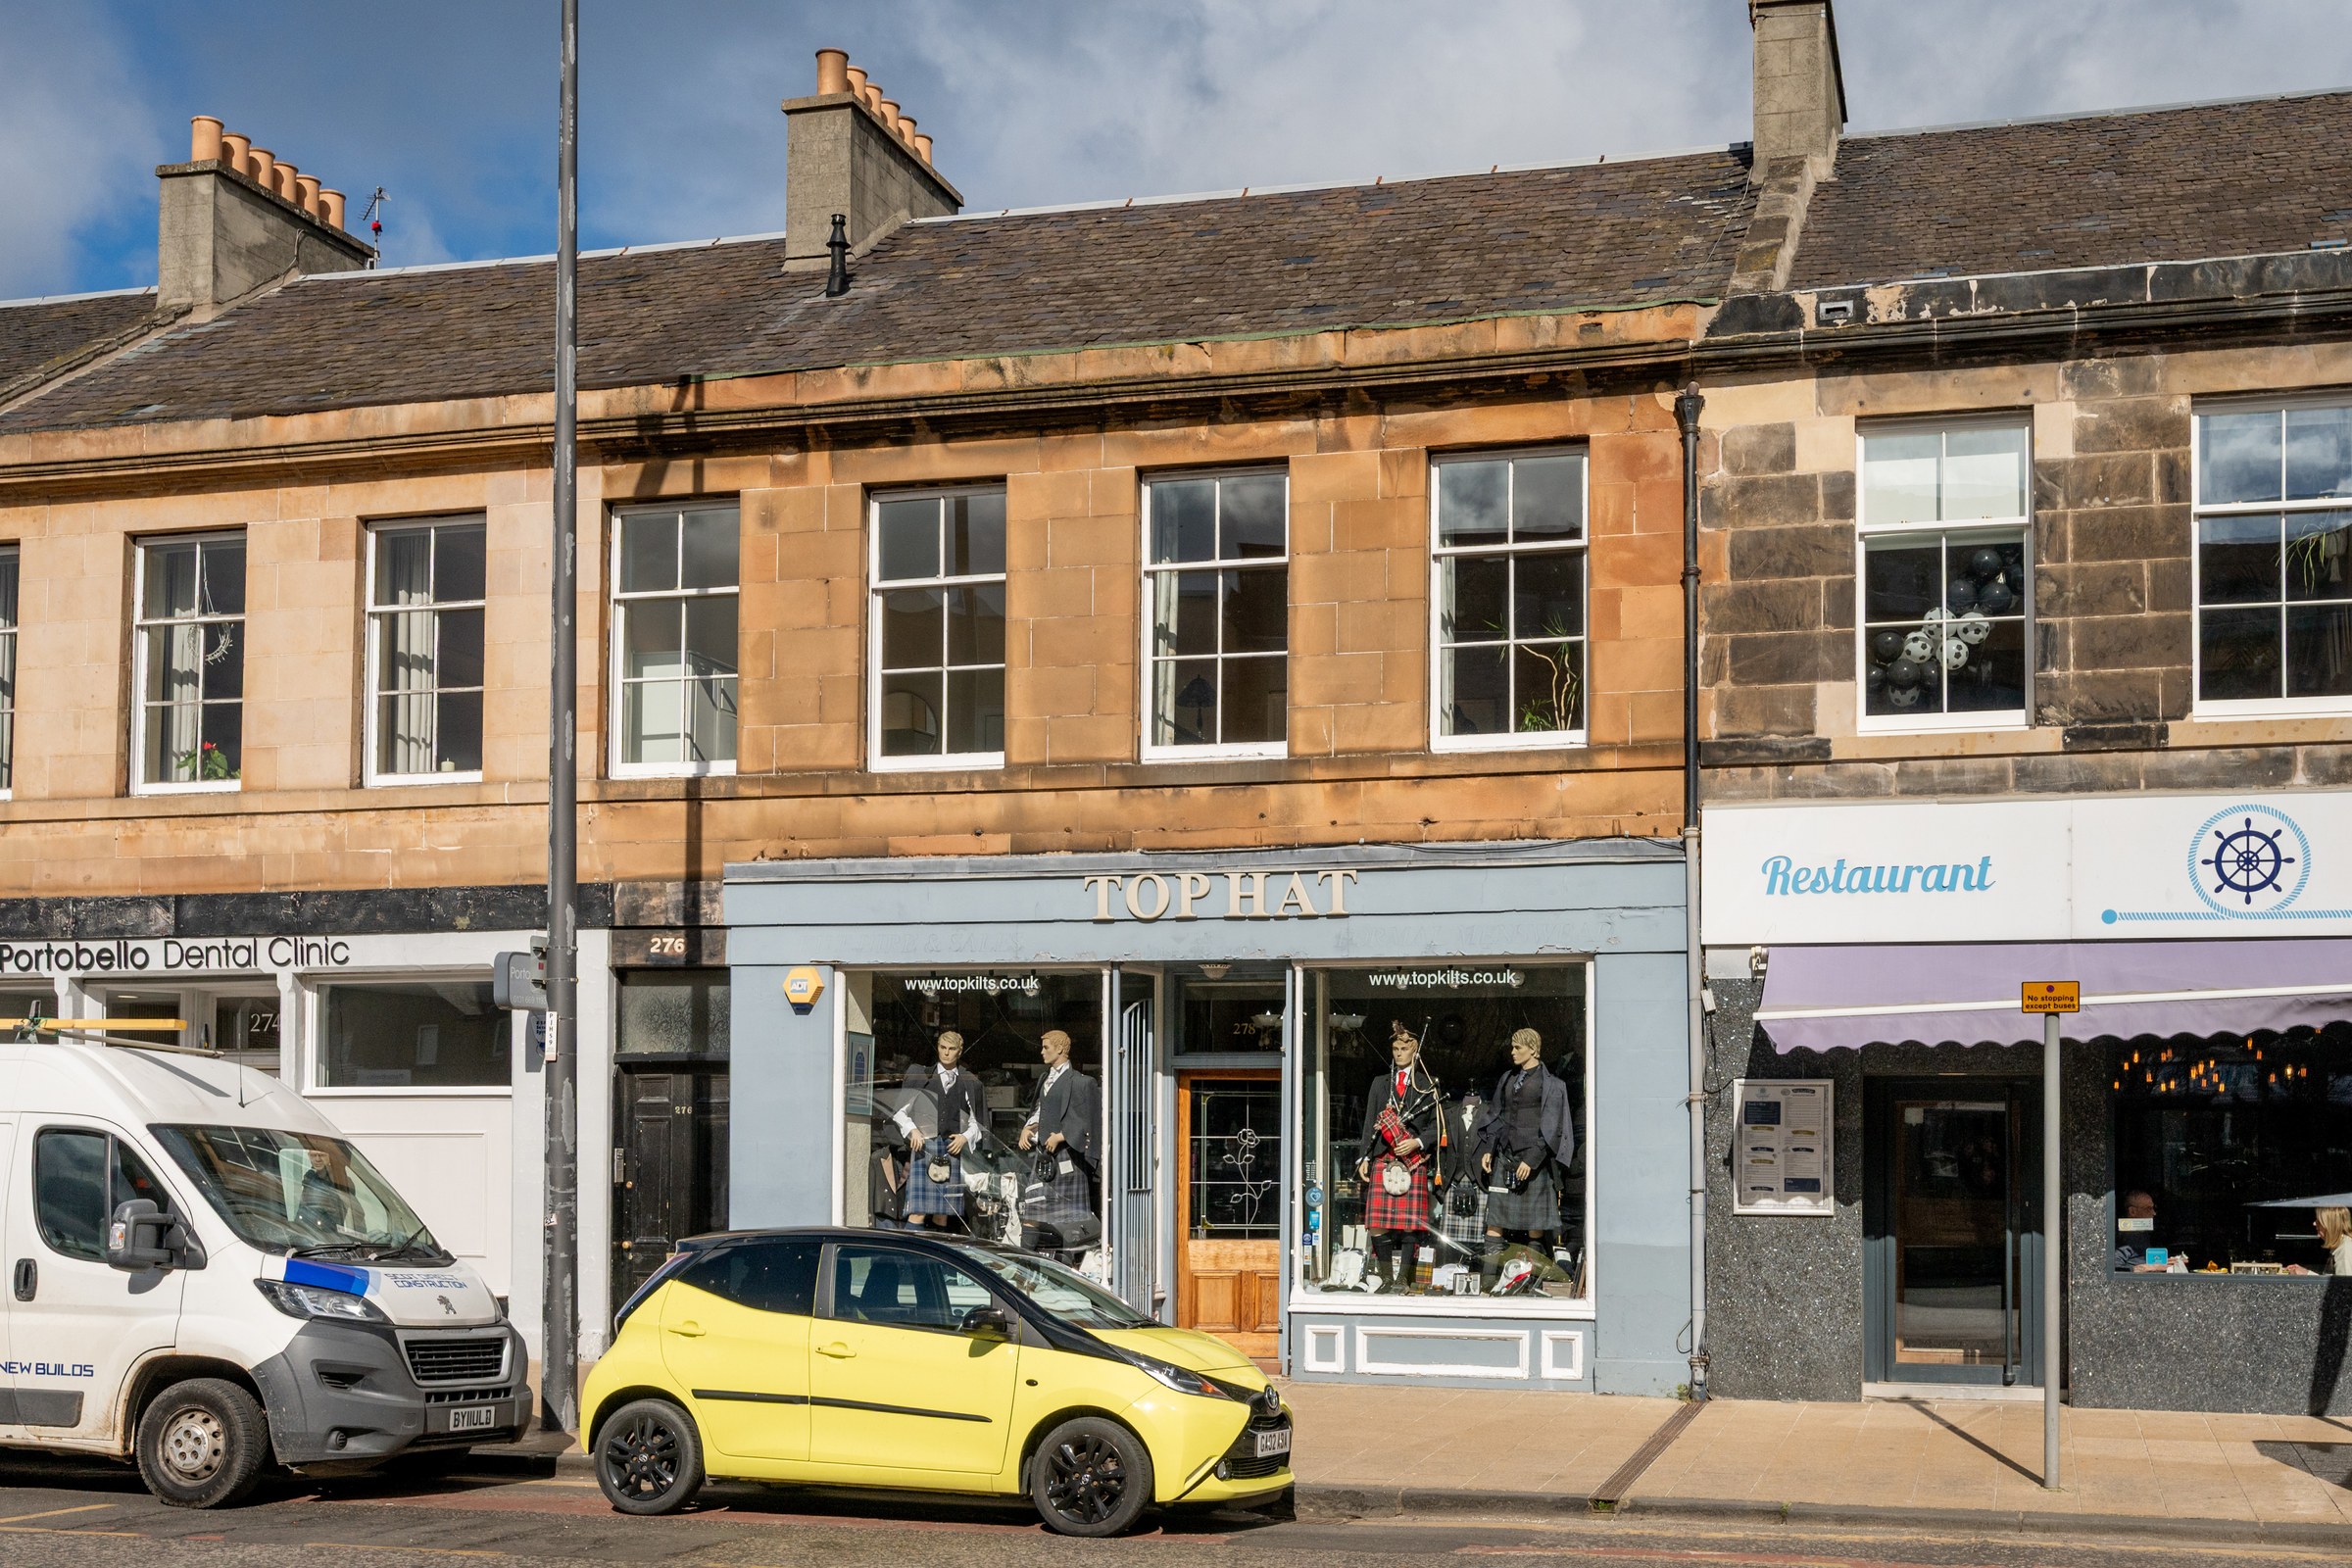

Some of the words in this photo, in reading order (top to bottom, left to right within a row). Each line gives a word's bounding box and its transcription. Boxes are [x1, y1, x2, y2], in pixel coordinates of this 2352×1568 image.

[1761, 856, 1996, 896] Restaurant
[1084, 871, 1211, 922] TOP
[1223, 869, 1358, 920] HAT
[0, 941, 149, 972] Portobello
[164, 938, 259, 969] Dental
[268, 936, 350, 967] Clinic
[649, 937, 685, 954] 276
[790, 981, 808, 991] ADT
[905, 975, 1040, 994] www.topkilts.co.uk
[1369, 969, 1516, 989] www.topkilts.co.uk
[250, 1013, 280, 1032] 274
[1233, 1022, 1255, 1035] 278
[674, 1105, 693, 1115] 276
[393, 1280, 468, 1289] CONSTRUCTION
[0, 1361, 31, 1374] NEW
[35, 1362, 94, 1377] BUILDS
